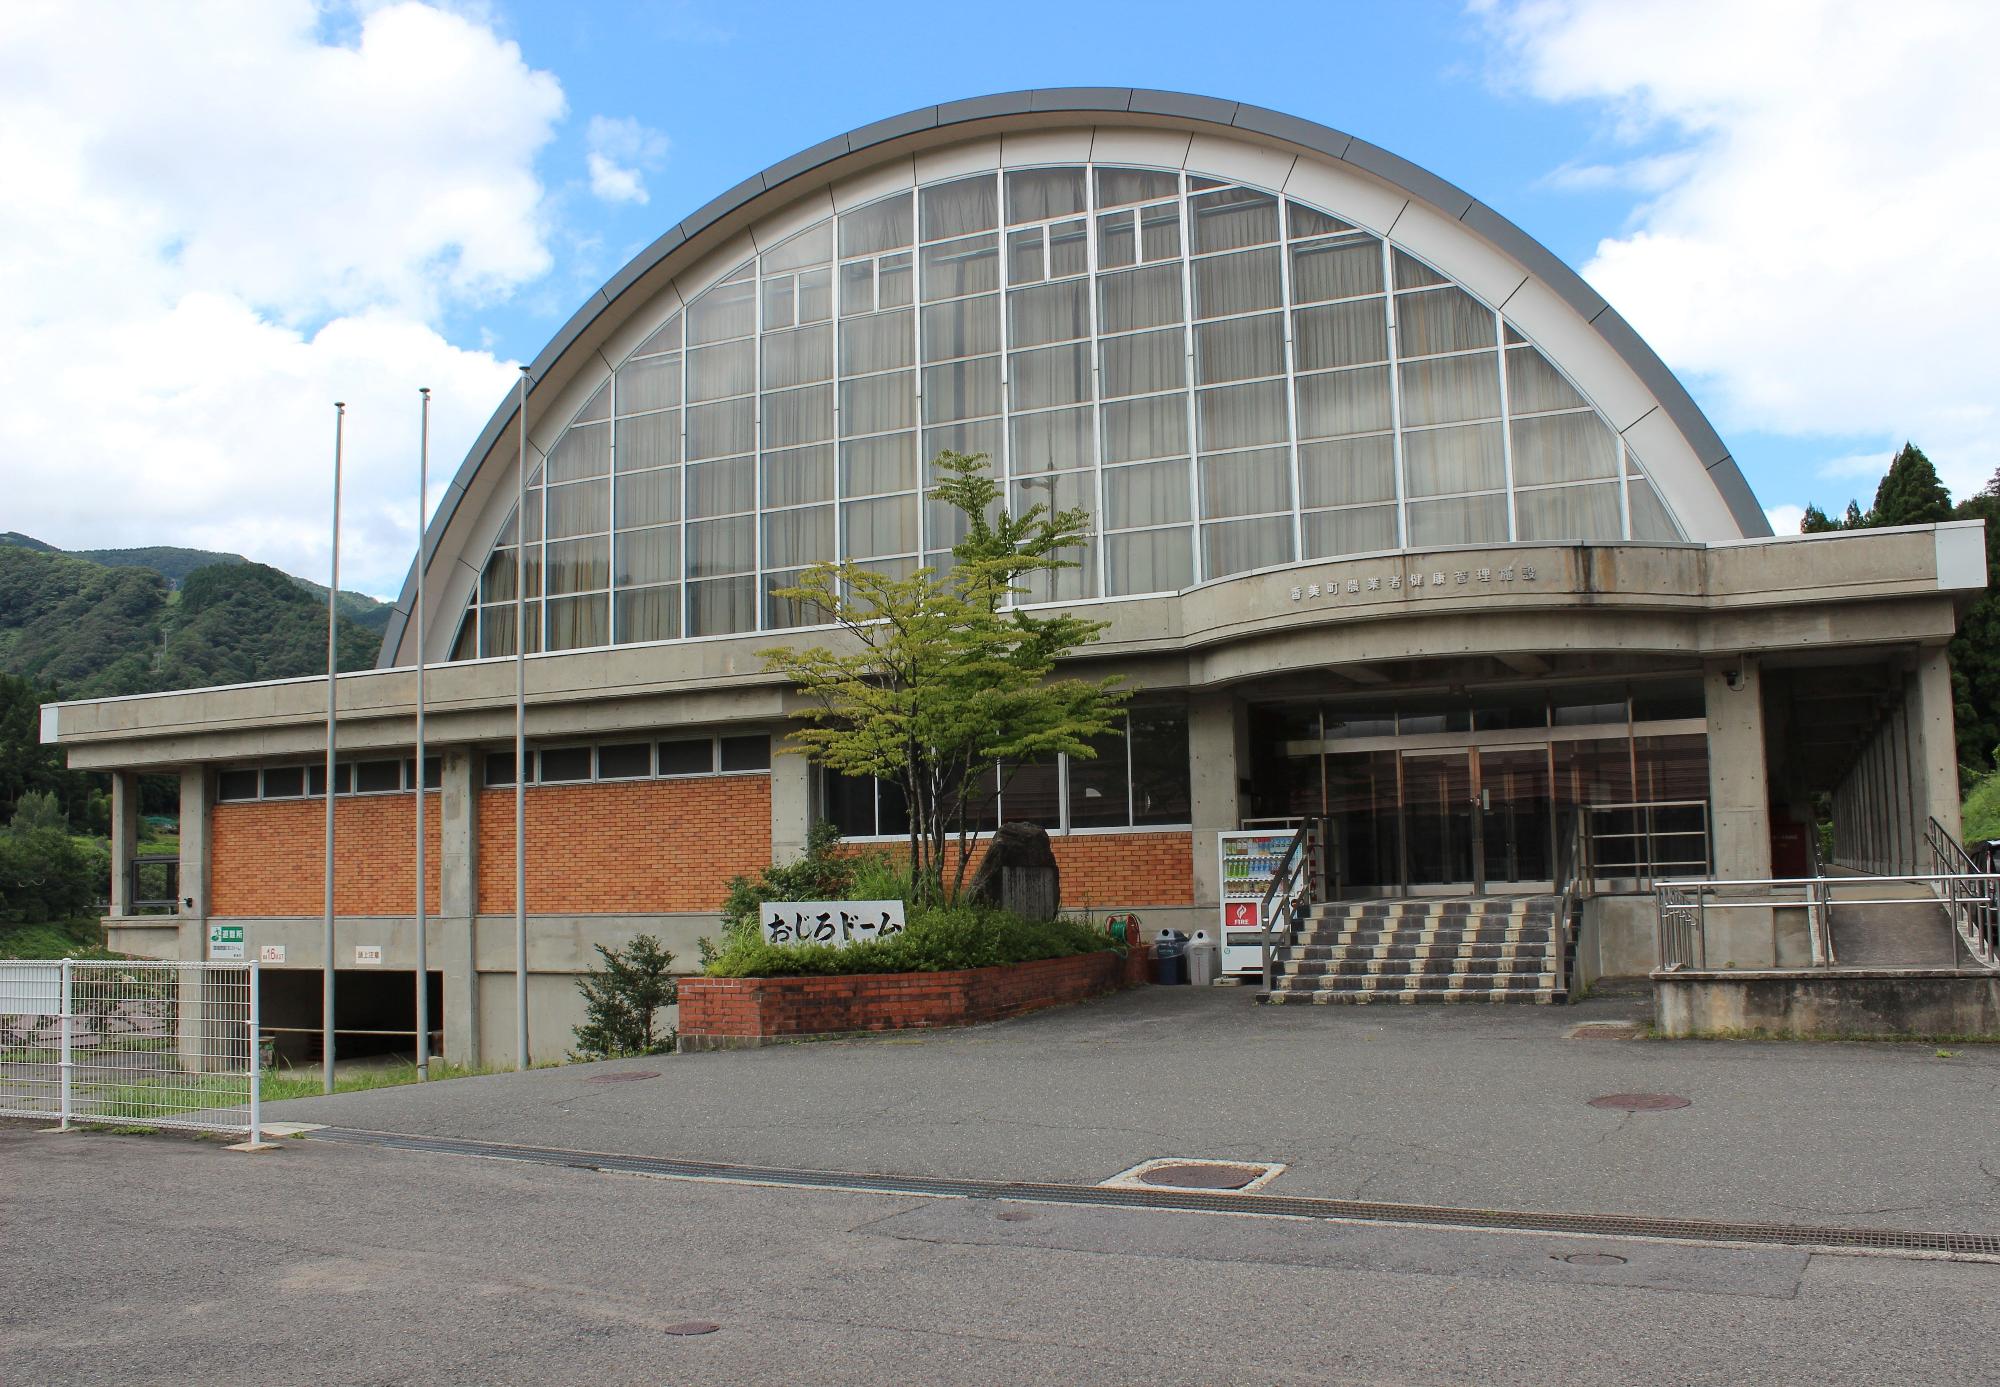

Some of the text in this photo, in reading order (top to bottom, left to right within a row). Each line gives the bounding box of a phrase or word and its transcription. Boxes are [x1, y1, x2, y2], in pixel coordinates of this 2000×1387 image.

[768, 911, 903, 943] おじろドーム
